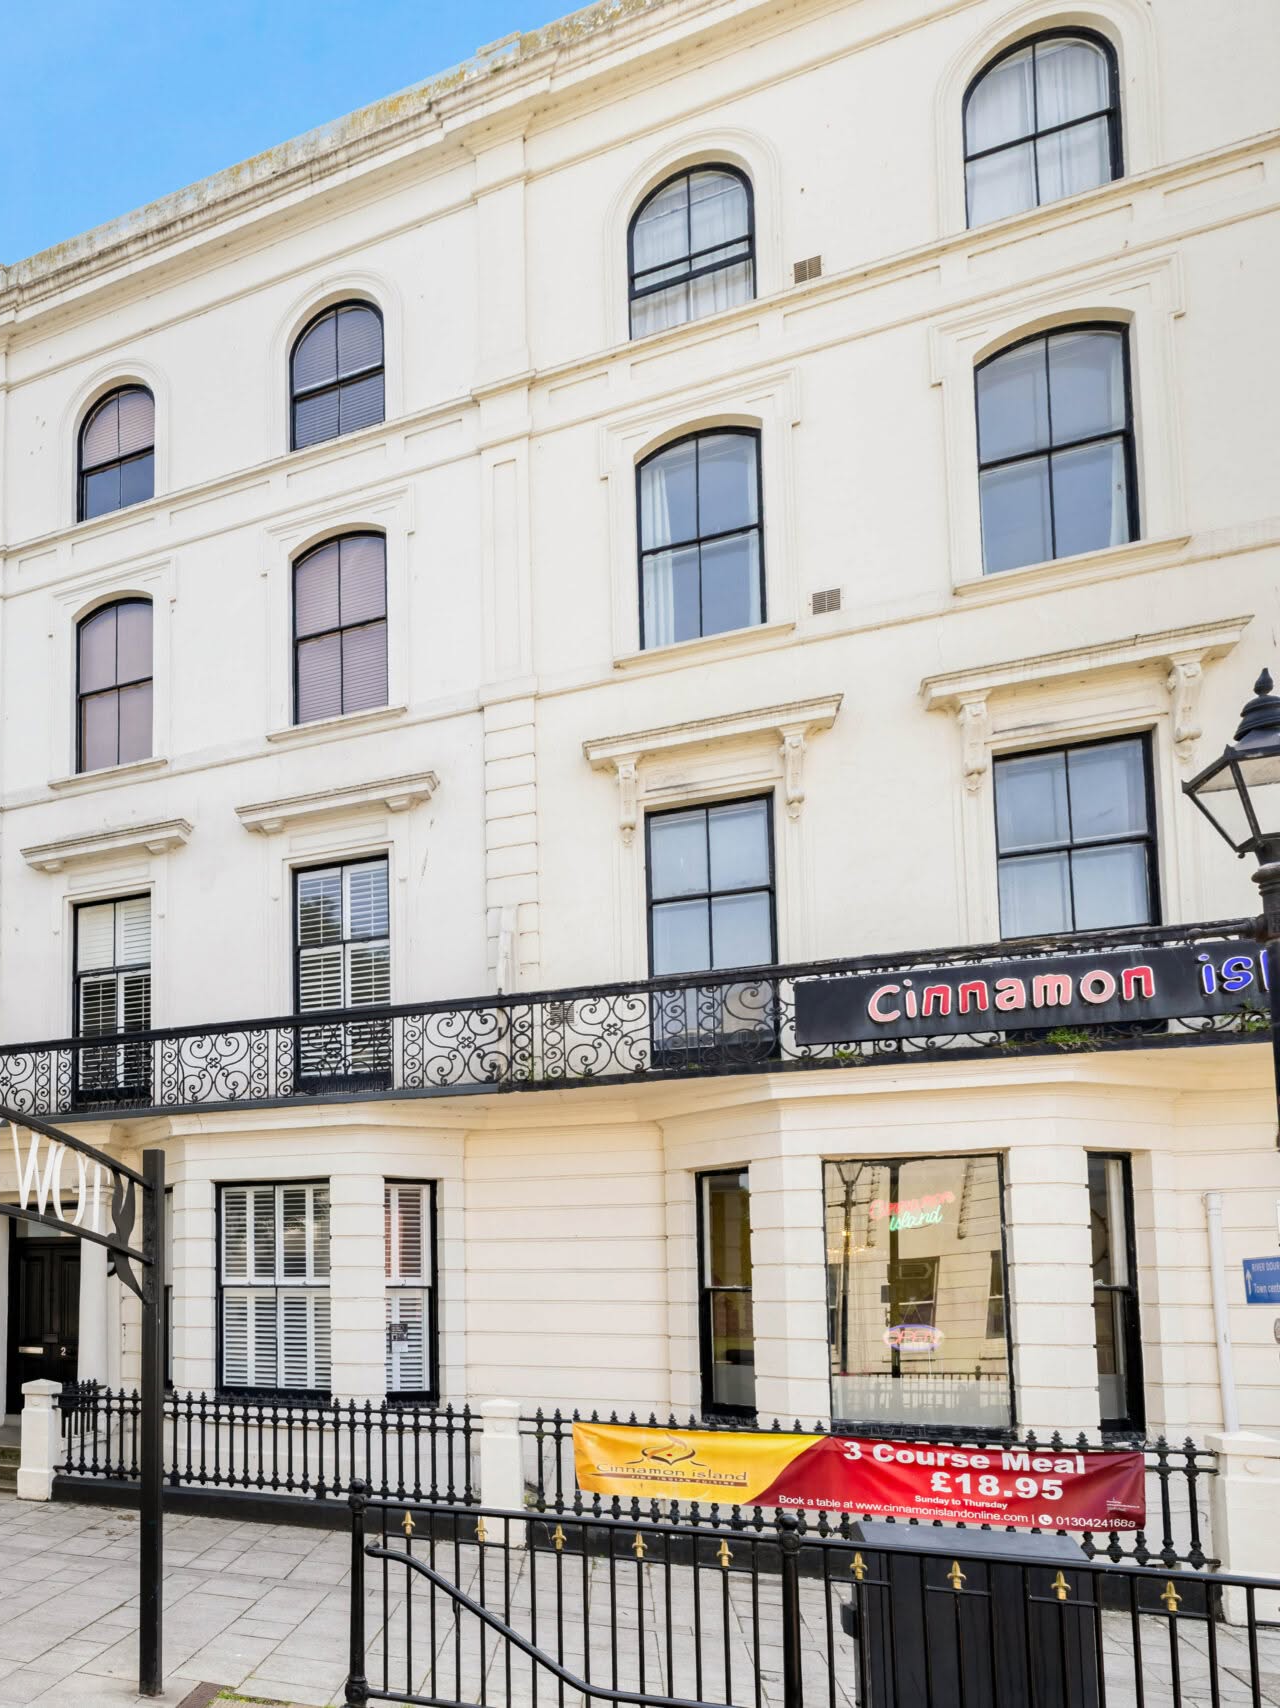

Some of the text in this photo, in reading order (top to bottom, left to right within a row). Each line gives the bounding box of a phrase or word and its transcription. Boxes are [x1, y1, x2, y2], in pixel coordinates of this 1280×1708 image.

[868, 966, 1156, 1023] Cinnamon
[60, 1346, 67, 1356] 2
[843, 1441, 1086, 1474] 3 Course Meal
[596, 1463, 748, 1481] Cinnamon island
[930, 1471, 1064, 1500] £18.95
[778, 1494, 805, 1505] Book
[816, 1498, 841, 1508] table
[843, 1500, 853, 1509] at
[856, 1502, 1029, 1522] www.cinnamonislandonline.com
[914, 1495, 949, 1506] Sunday
[963, 1498, 1008, 1510] Thursday
